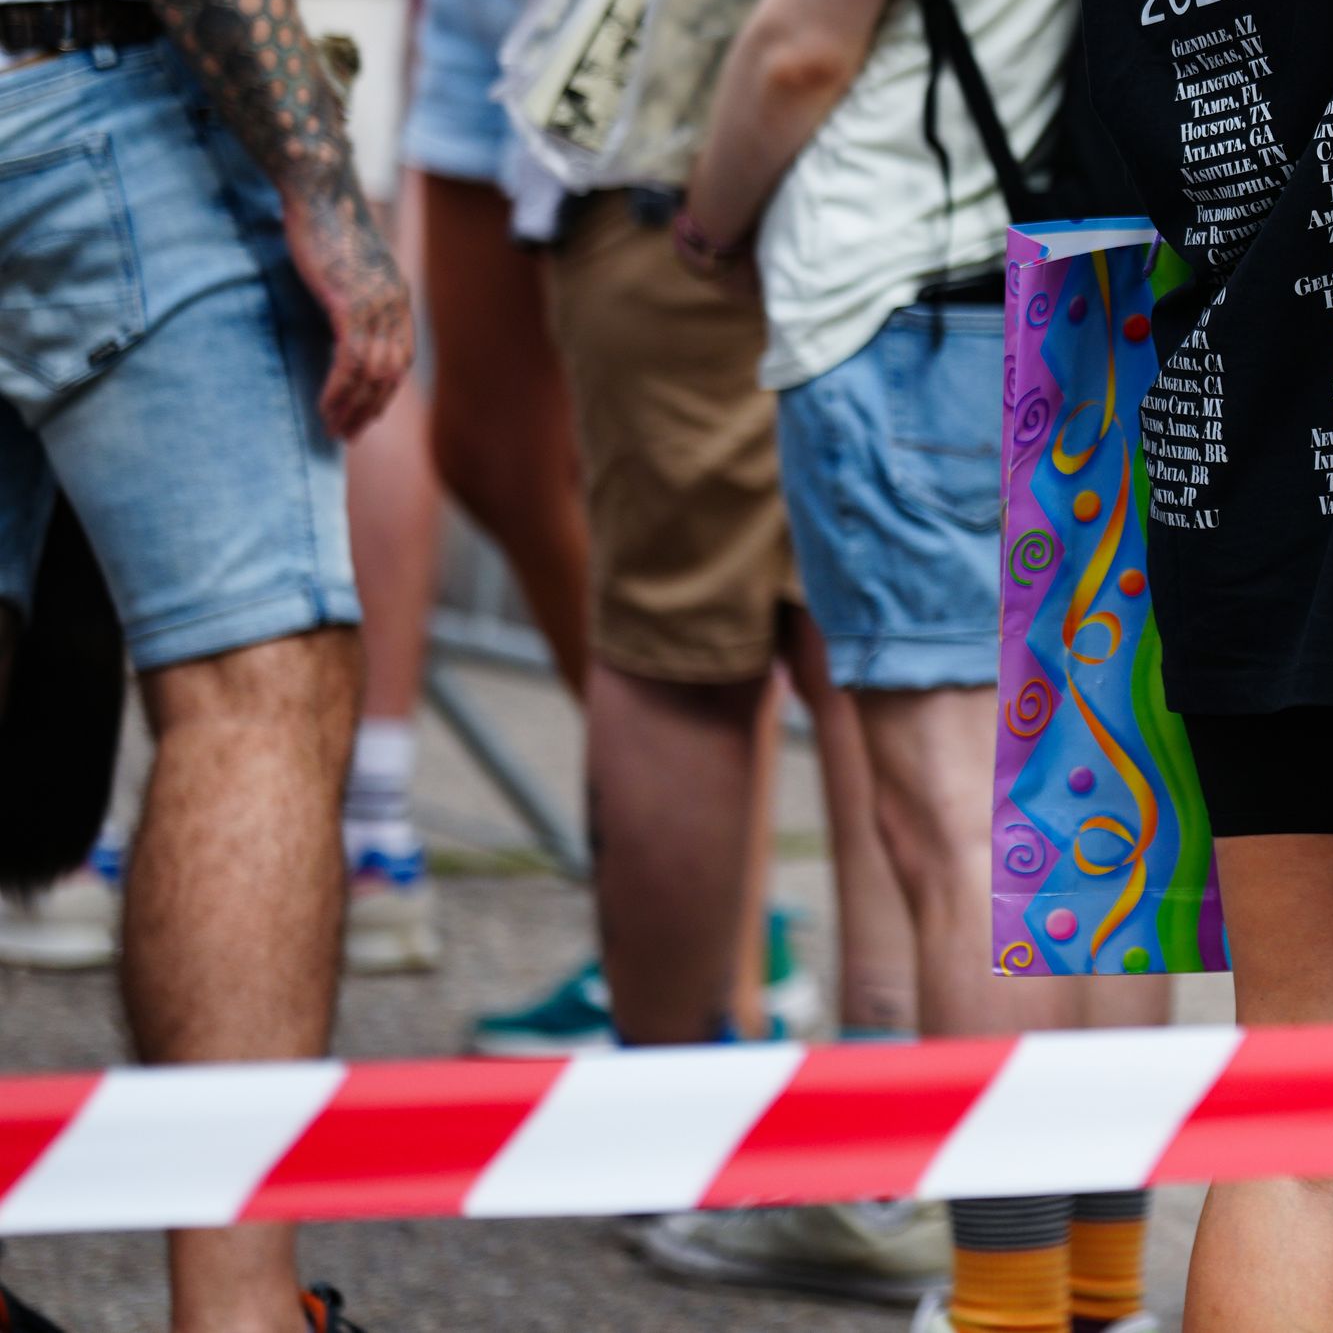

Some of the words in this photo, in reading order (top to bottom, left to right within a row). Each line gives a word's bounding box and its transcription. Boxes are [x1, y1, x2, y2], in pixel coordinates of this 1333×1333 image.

[1171, 27, 1233, 58] GLENDALE,
[1234, 14, 1257, 37] AZ
[1172, 62, 1199, 80] LAS
[1196, 49, 1243, 71] VEGAS,
[1240, 35, 1264, 58] NV
[1174, 70, 1249, 102] ARLINGTON,
[1248, 56, 1274, 79] TX
[1191, 96, 1239, 118] TAMPA,
[1241, 83, 1263, 106] FL
[1180, 116, 1246, 143] HOUSTON,
[1250, 102, 1273, 125] TX
[1183, 138, 1246, 164] ATLANTA,
[1250, 124, 1276, 147] GA
[1180, 157, 1258, 186] NASHVILLE,
[1258, 143, 1288, 167] TN
[1184, 227, 1208, 246] EAST
[1204, 353, 1225, 373] CA
[1204, 375, 1225, 396] CA
[1168, 394, 1199, 418] CITY,
[1202, 396, 1225, 418] MX
[1166, 416, 1200, 441] AIRES,
[1202, 420, 1224, 441] AR
[1204, 443, 1229, 463] BR
[1156, 460, 1188, 484] PAULO,
[1190, 464, 1210, 485] BR
[1180, 486, 1197, 507] JP
[1193, 509, 1220, 529] AU
